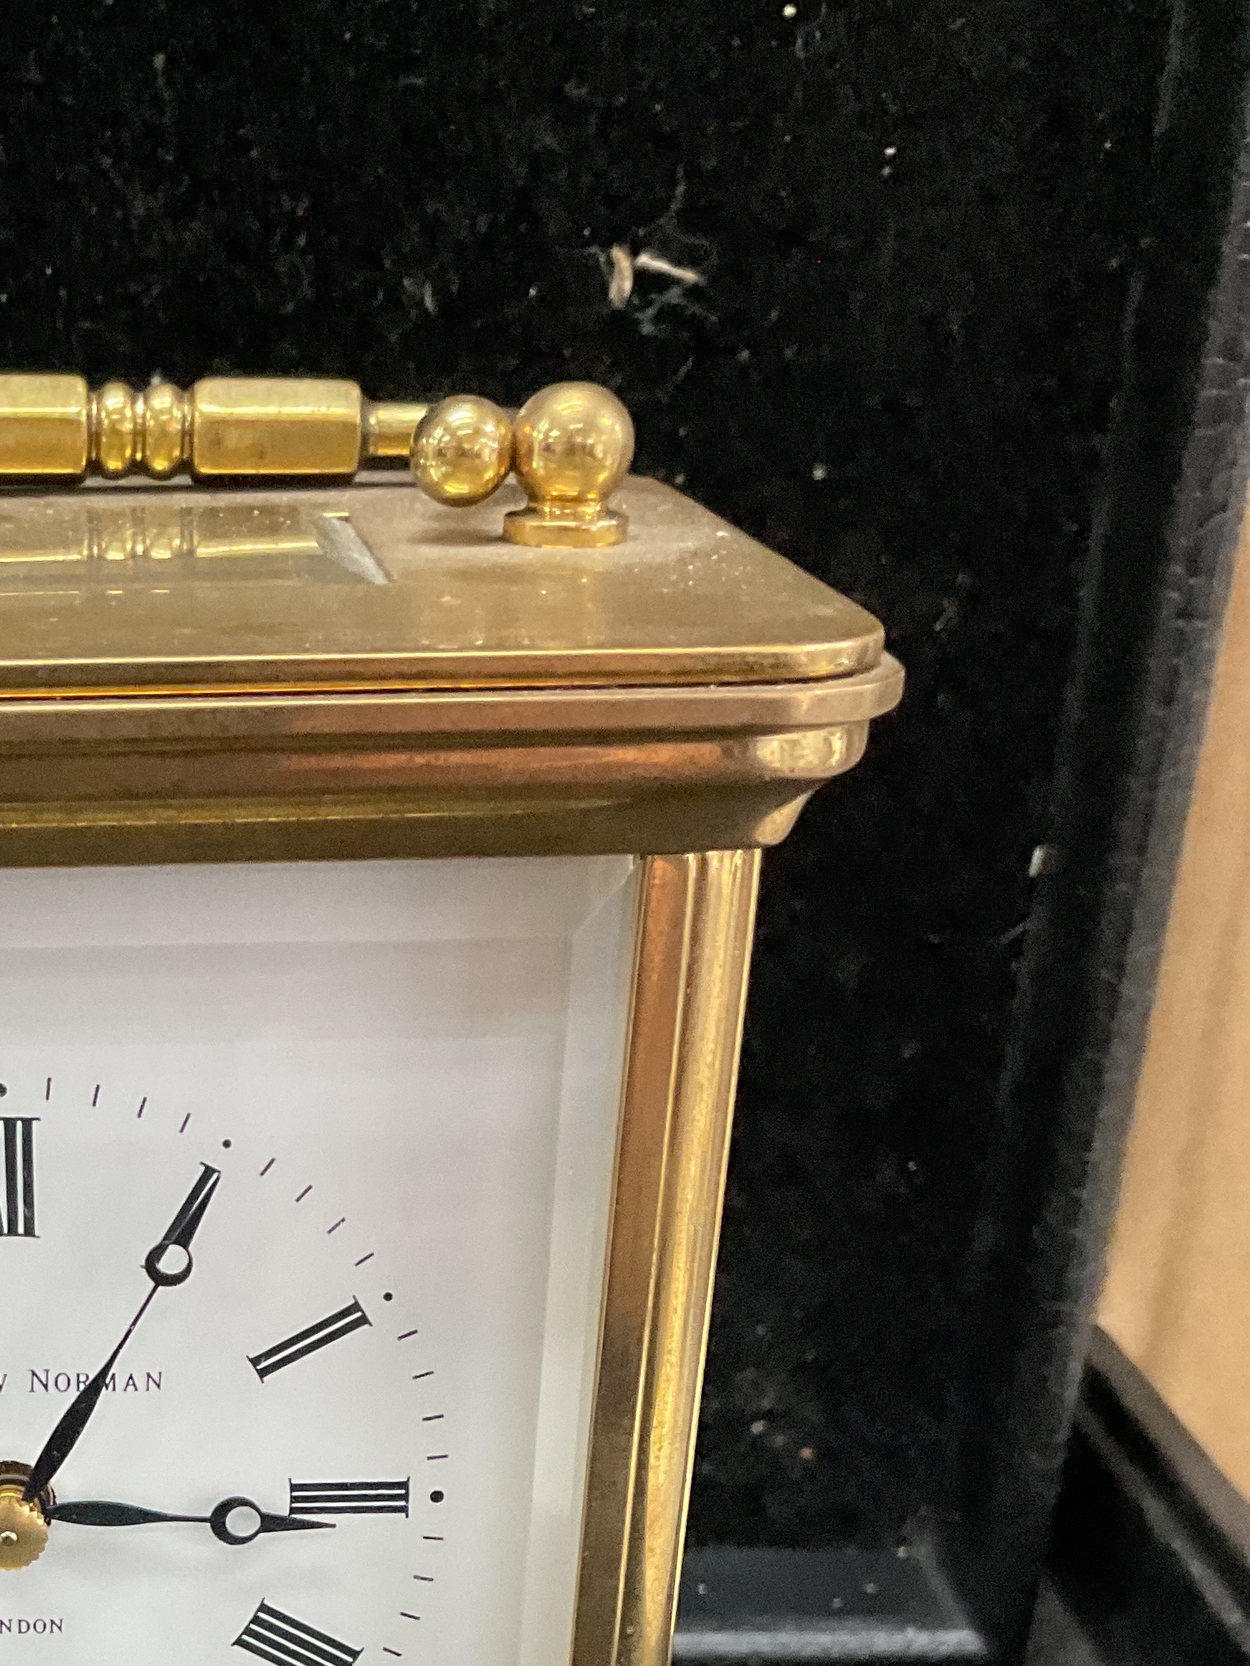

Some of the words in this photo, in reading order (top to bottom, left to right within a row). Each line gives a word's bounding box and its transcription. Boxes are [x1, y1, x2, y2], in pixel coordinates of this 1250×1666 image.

[247, 1296, 372, 1383] II
[28, 1369, 163, 1393] NORMAN
[287, 1476, 410, 1518] III
